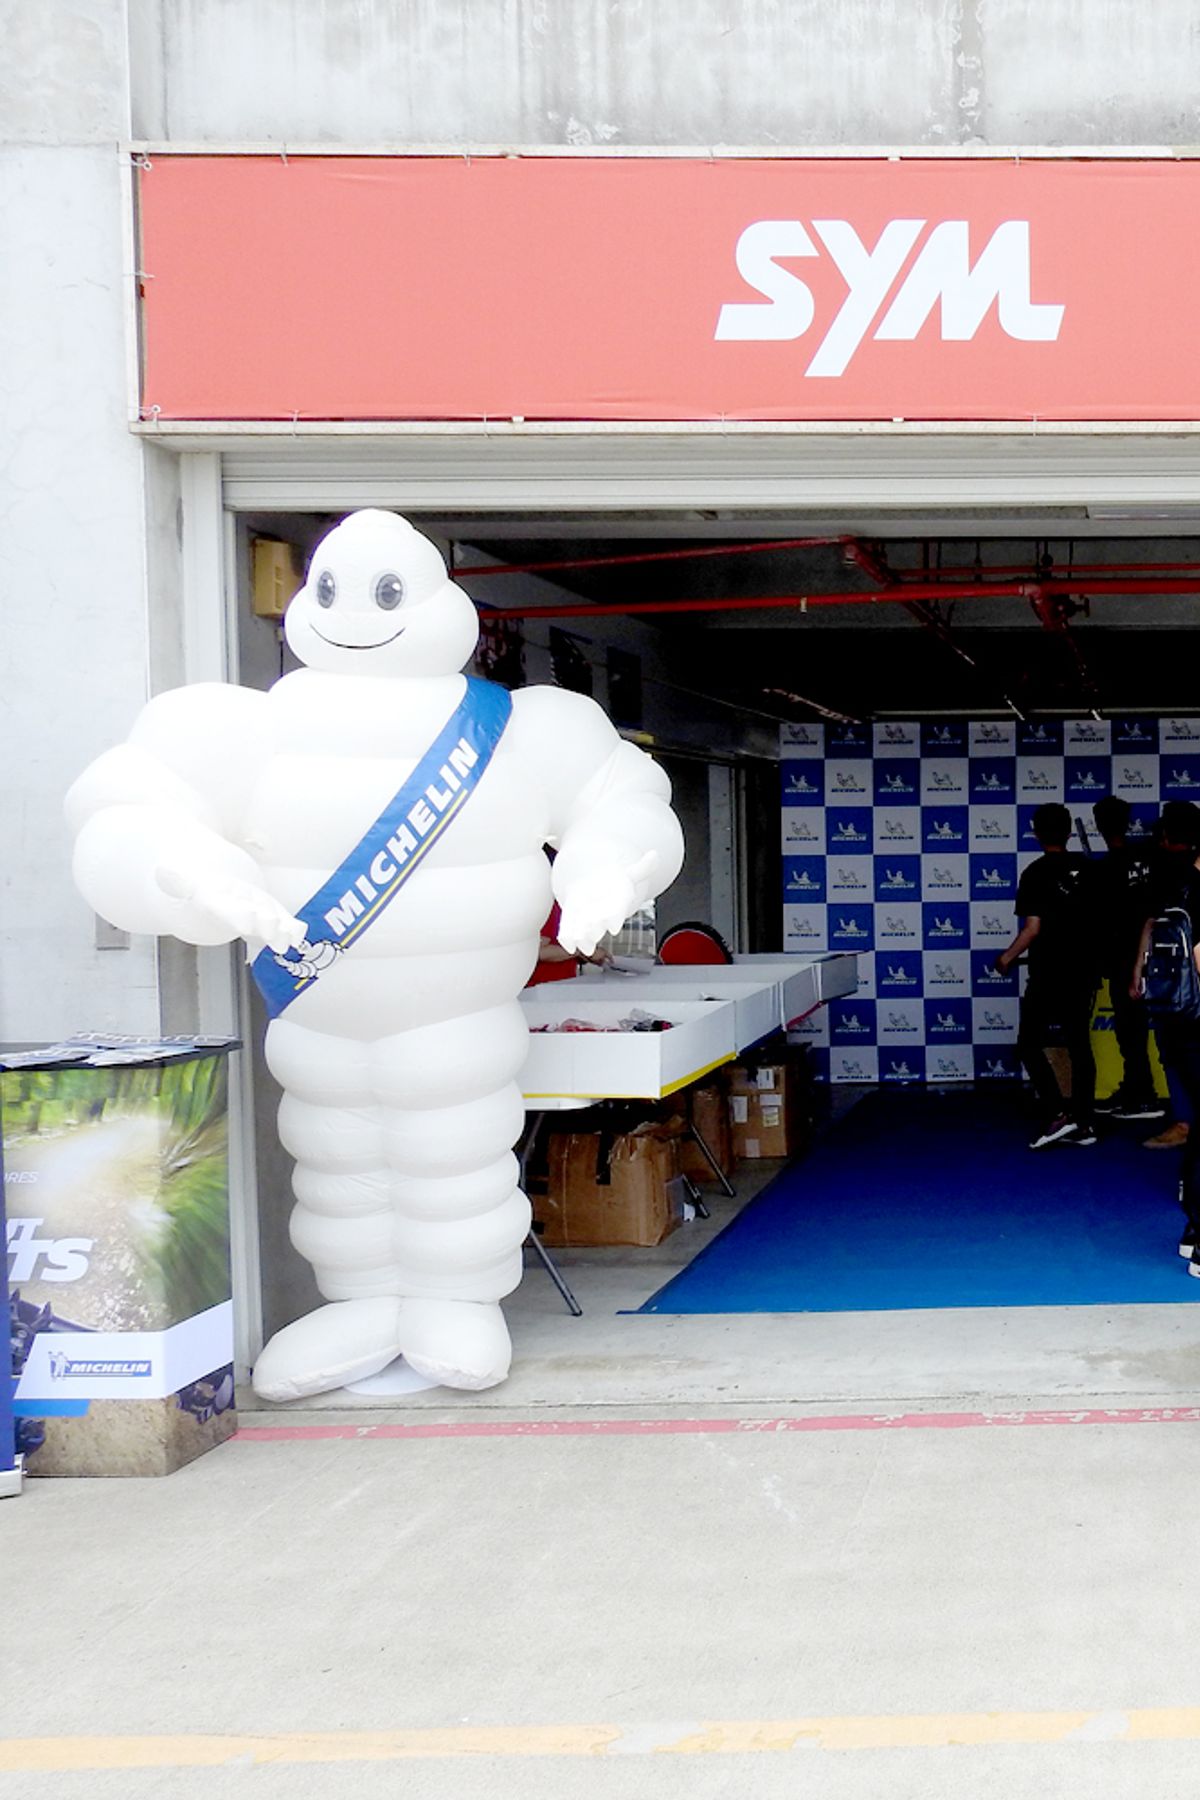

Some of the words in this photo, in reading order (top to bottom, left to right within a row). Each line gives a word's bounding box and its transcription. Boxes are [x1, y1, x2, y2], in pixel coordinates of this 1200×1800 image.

[714, 219, 1065, 377] SYM
[323, 736, 480, 937] MICHELIN
[4, 1172, 39, 1183] RES
[70, 1362, 151, 1373] MICHELIN
